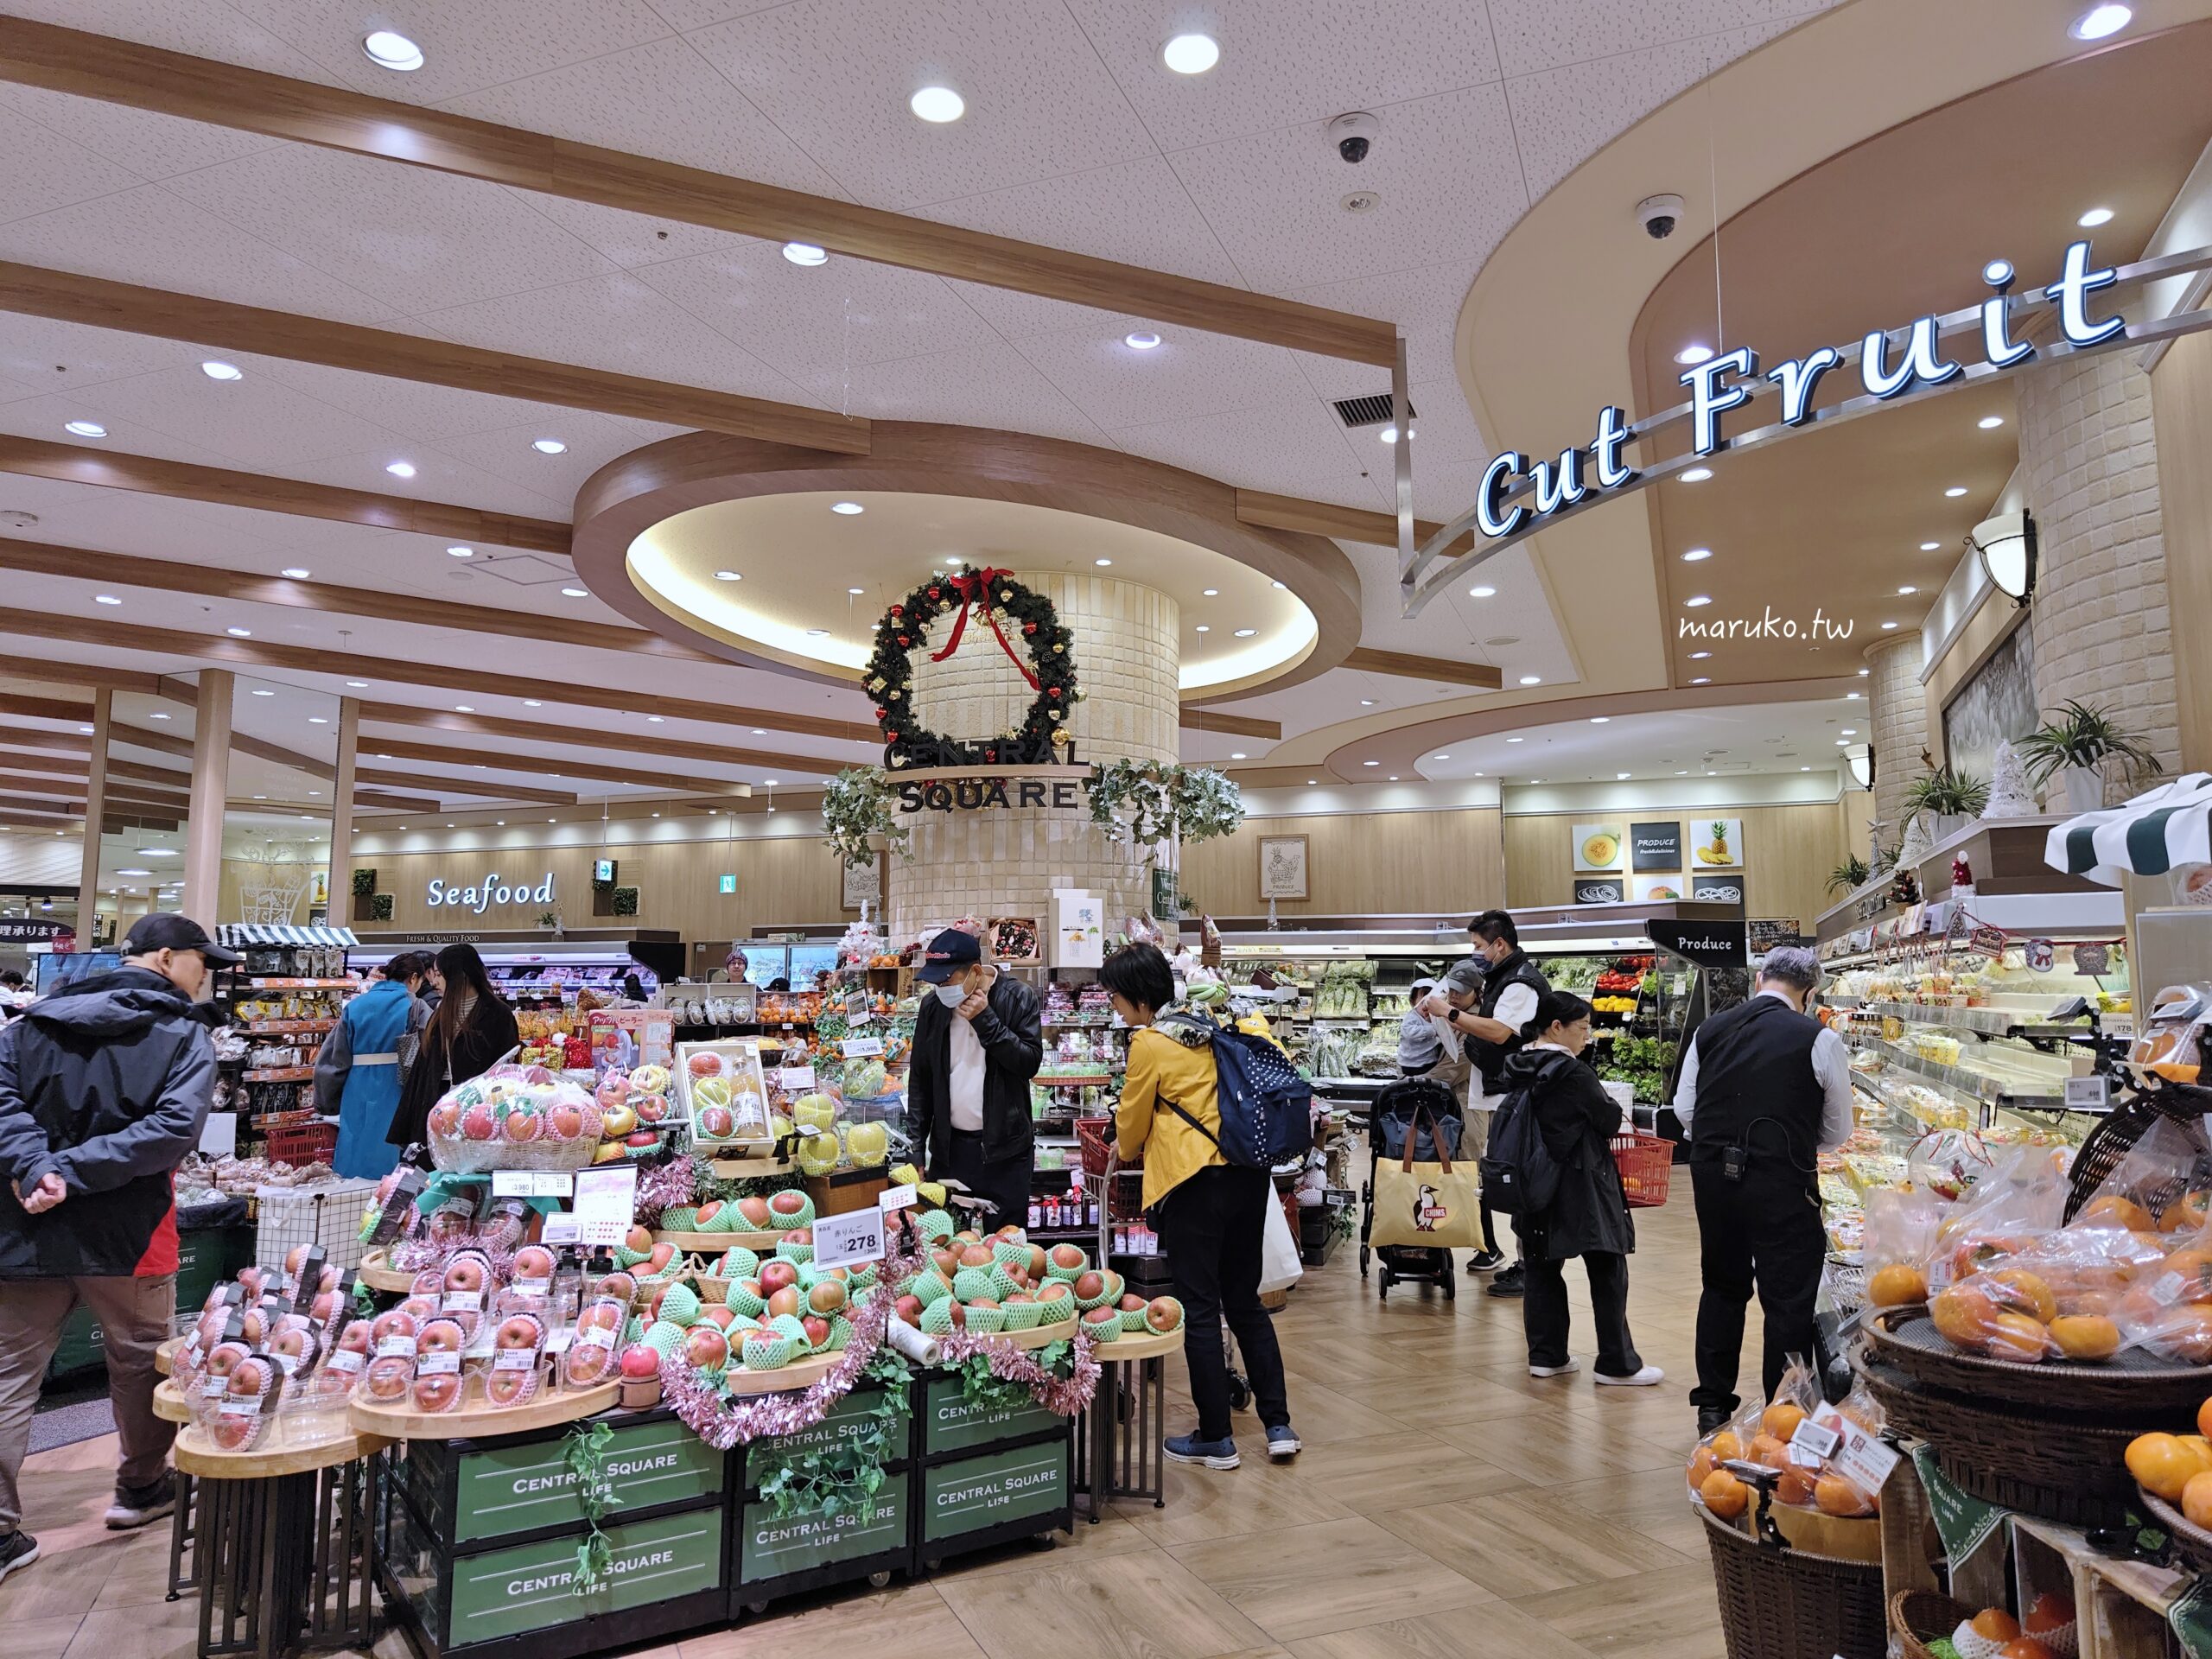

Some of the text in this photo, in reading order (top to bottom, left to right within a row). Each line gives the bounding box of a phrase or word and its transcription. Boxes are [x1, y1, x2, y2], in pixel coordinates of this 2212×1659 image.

[1475, 239, 2126, 538] Cut Fruit
[883, 740, 1090, 772] CENTRAL
[899, 781, 1078, 812] SQUARE
[1637, 838, 1675, 847] PRODUCE
[429, 873, 555, 913] Seafood
[433, 934, 459, 943] QUALITY
[1678, 936, 1732, 950] Produce
[1426, 1208, 1446, 1217] CHUMS
[848, 1235, 876, 1252] 278
[988, 1412, 1011, 1424] LIFE
[817, 1443, 842, 1456] LIFE
[607, 1453, 677, 1477] SQUARE
[582, 1483, 612, 1497] LIFE
[937, 1470, 1058, 1506] CENTRAL SQUARE
[988, 1496, 1009, 1508] LIFE
[1933, 1479, 1963, 1515] SQUARE
[756, 1519, 830, 1545] CENTRAL
[815, 1534, 840, 1547] LIFE
[602, 1551, 673, 1575] SQUARE
[577, 1582, 607, 1596] LIFE
